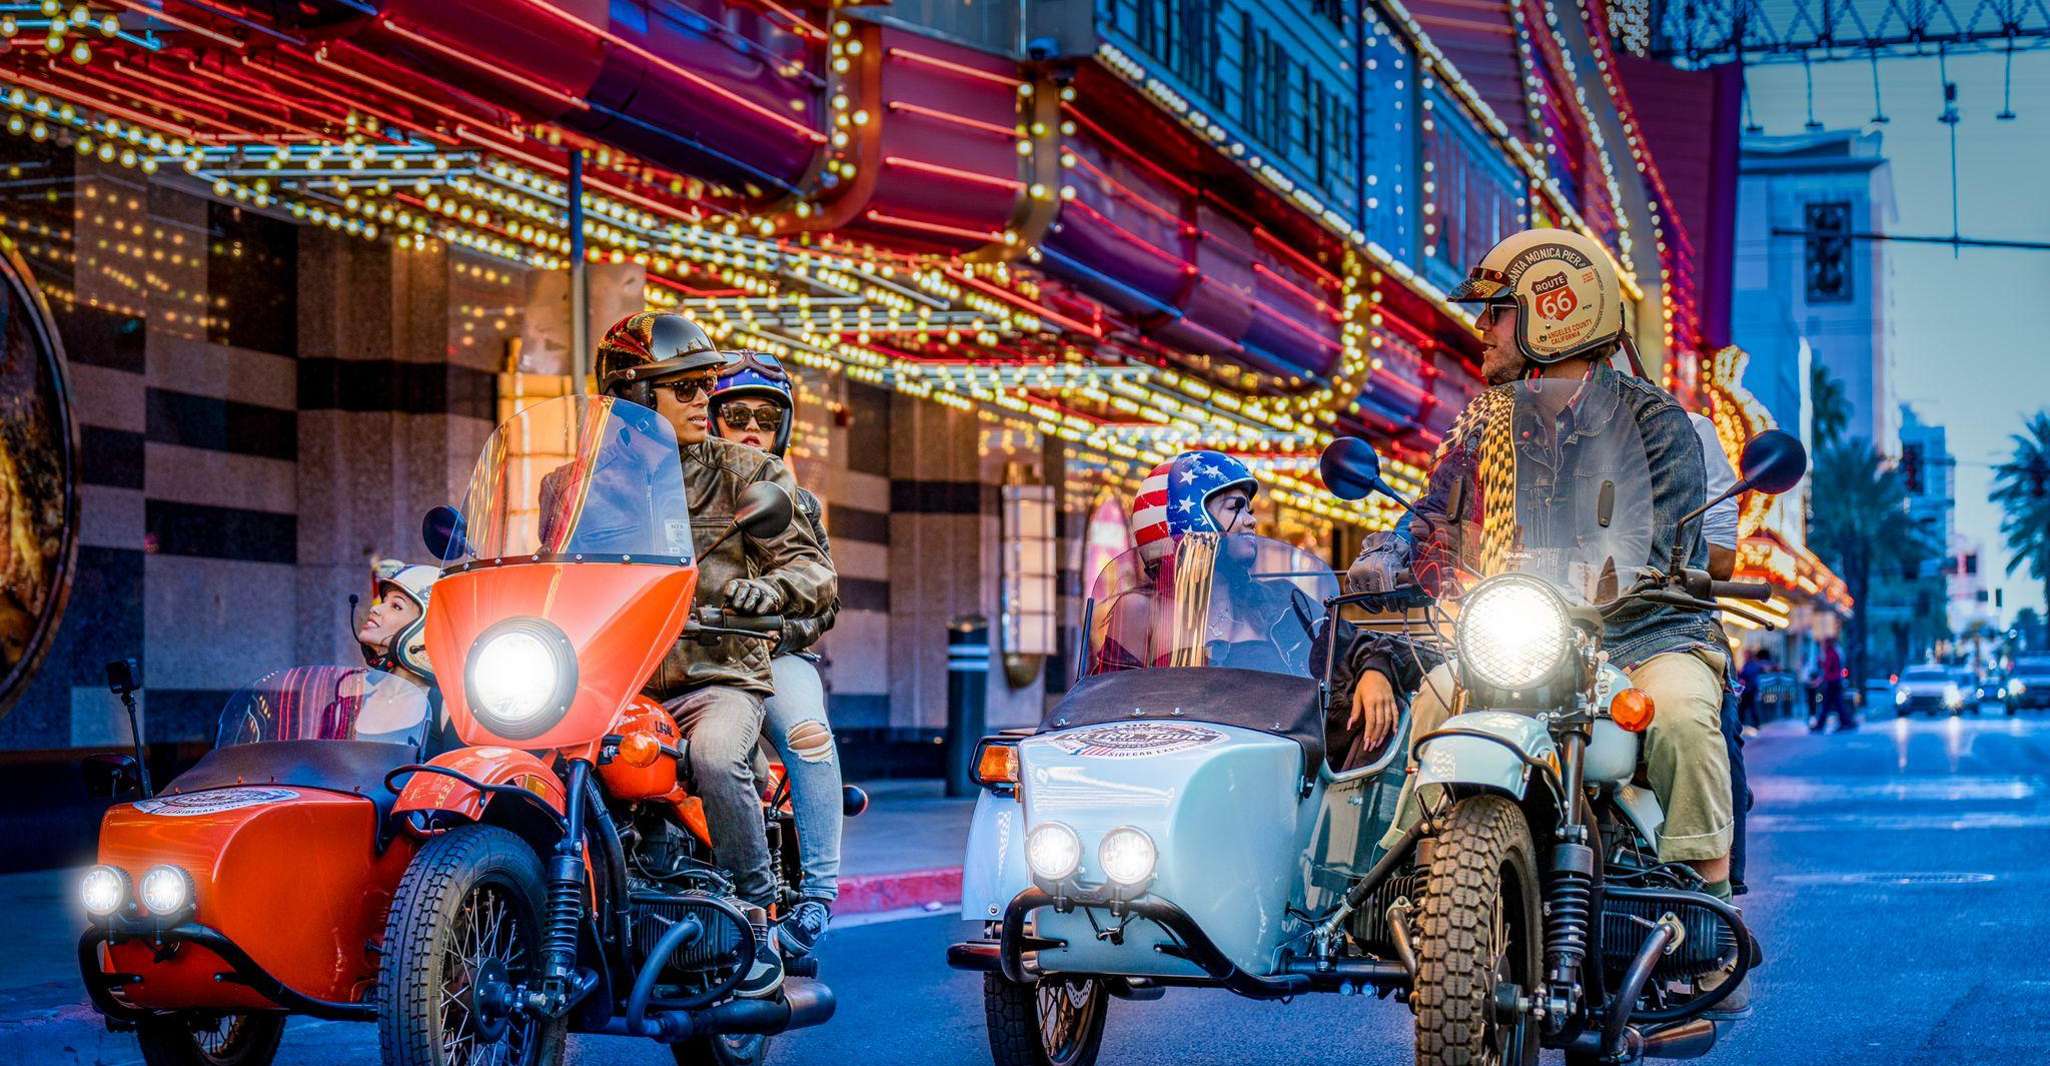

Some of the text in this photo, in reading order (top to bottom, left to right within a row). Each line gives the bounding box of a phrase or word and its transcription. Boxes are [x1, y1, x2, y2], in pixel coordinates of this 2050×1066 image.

[1509, 247, 1581, 287] SANTA MONICA PIER
[1535, 275, 1565, 292] ROUTE
[1542, 290, 1572, 317] 66
